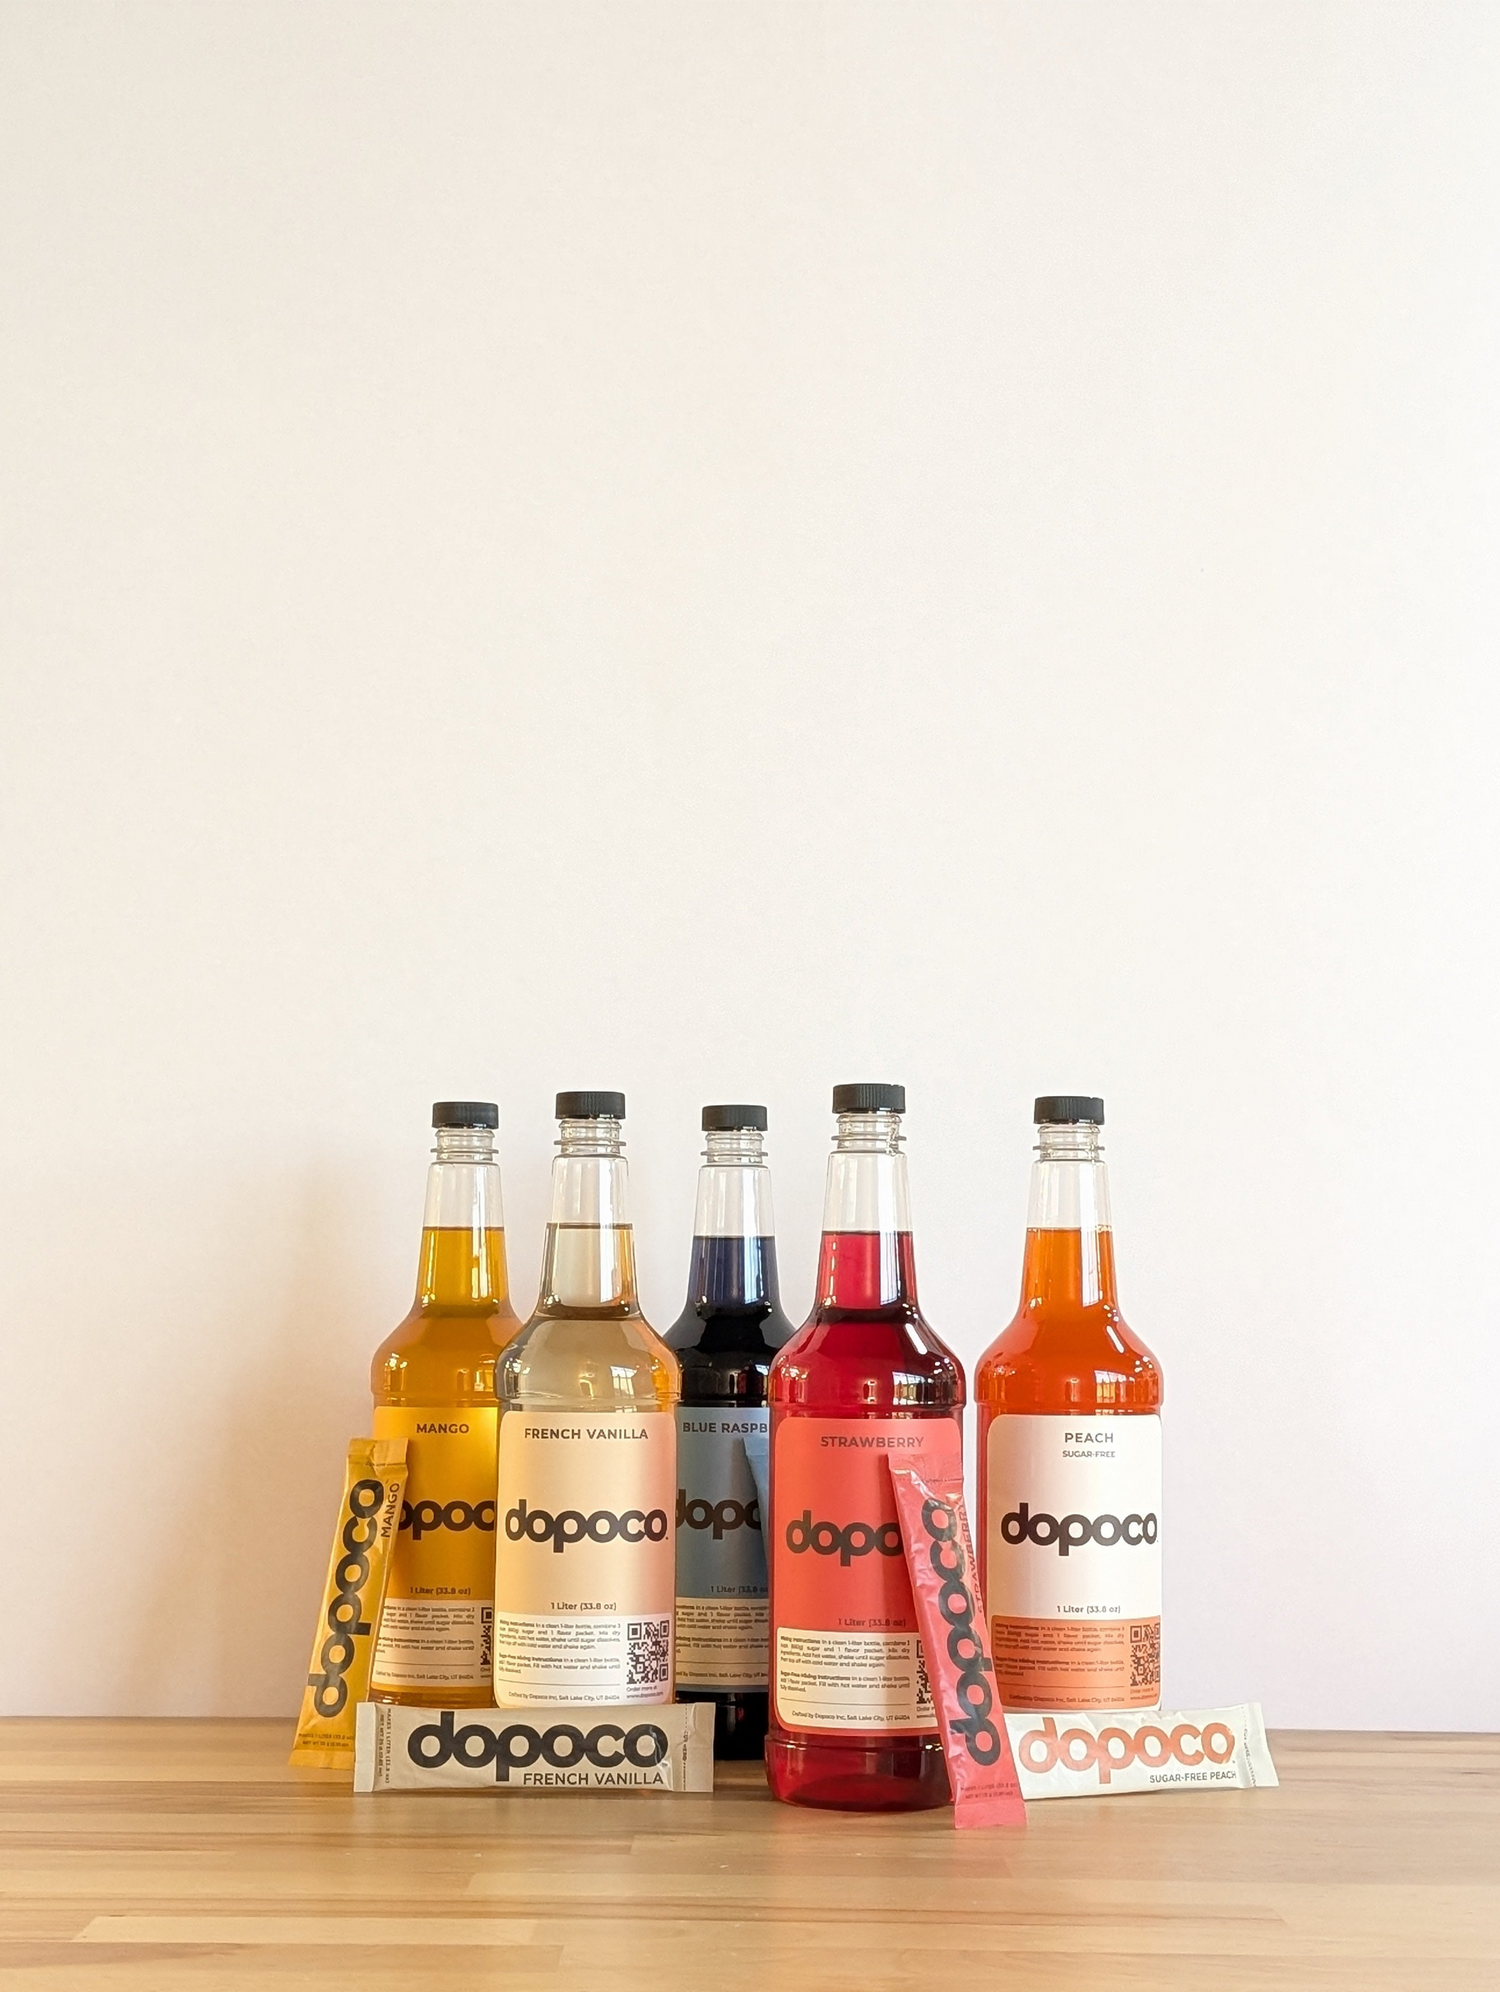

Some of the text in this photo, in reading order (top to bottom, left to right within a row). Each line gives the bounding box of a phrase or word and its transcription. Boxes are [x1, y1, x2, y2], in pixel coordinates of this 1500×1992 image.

[416, 1424, 470, 1433] MANGO
[525, 1428, 648, 1440] FRENCH VANILLA
[683, 1422, 768, 1433] BLUE RASPB
[821, 1436, 924, 1449] STRAWBERRY
[1065, 1433, 1114, 1443] PEACH
[1063, 1450, 1115, 1458] SUGAR-FREE
[381, 1483, 400, 1538] MANGO
[505, 1499, 668, 1553] dopoco
[1001, 1503, 1158, 1556] dopoco
[308, 1479, 384, 1718] dopoco
[551, 1602, 617, 1611] 1 Liter (33.8 oz)
[844, 1618, 866, 1626] Liter
[921, 1499, 1001, 1765] dopoco
[408, 1711, 669, 1782] dopoco
[1019, 1717, 1235, 1784] dopoco
[522, 1772, 664, 1786] FRENCH VANILLA
[1150, 1770, 1237, 1783] SUGAR-FREE PEACH
